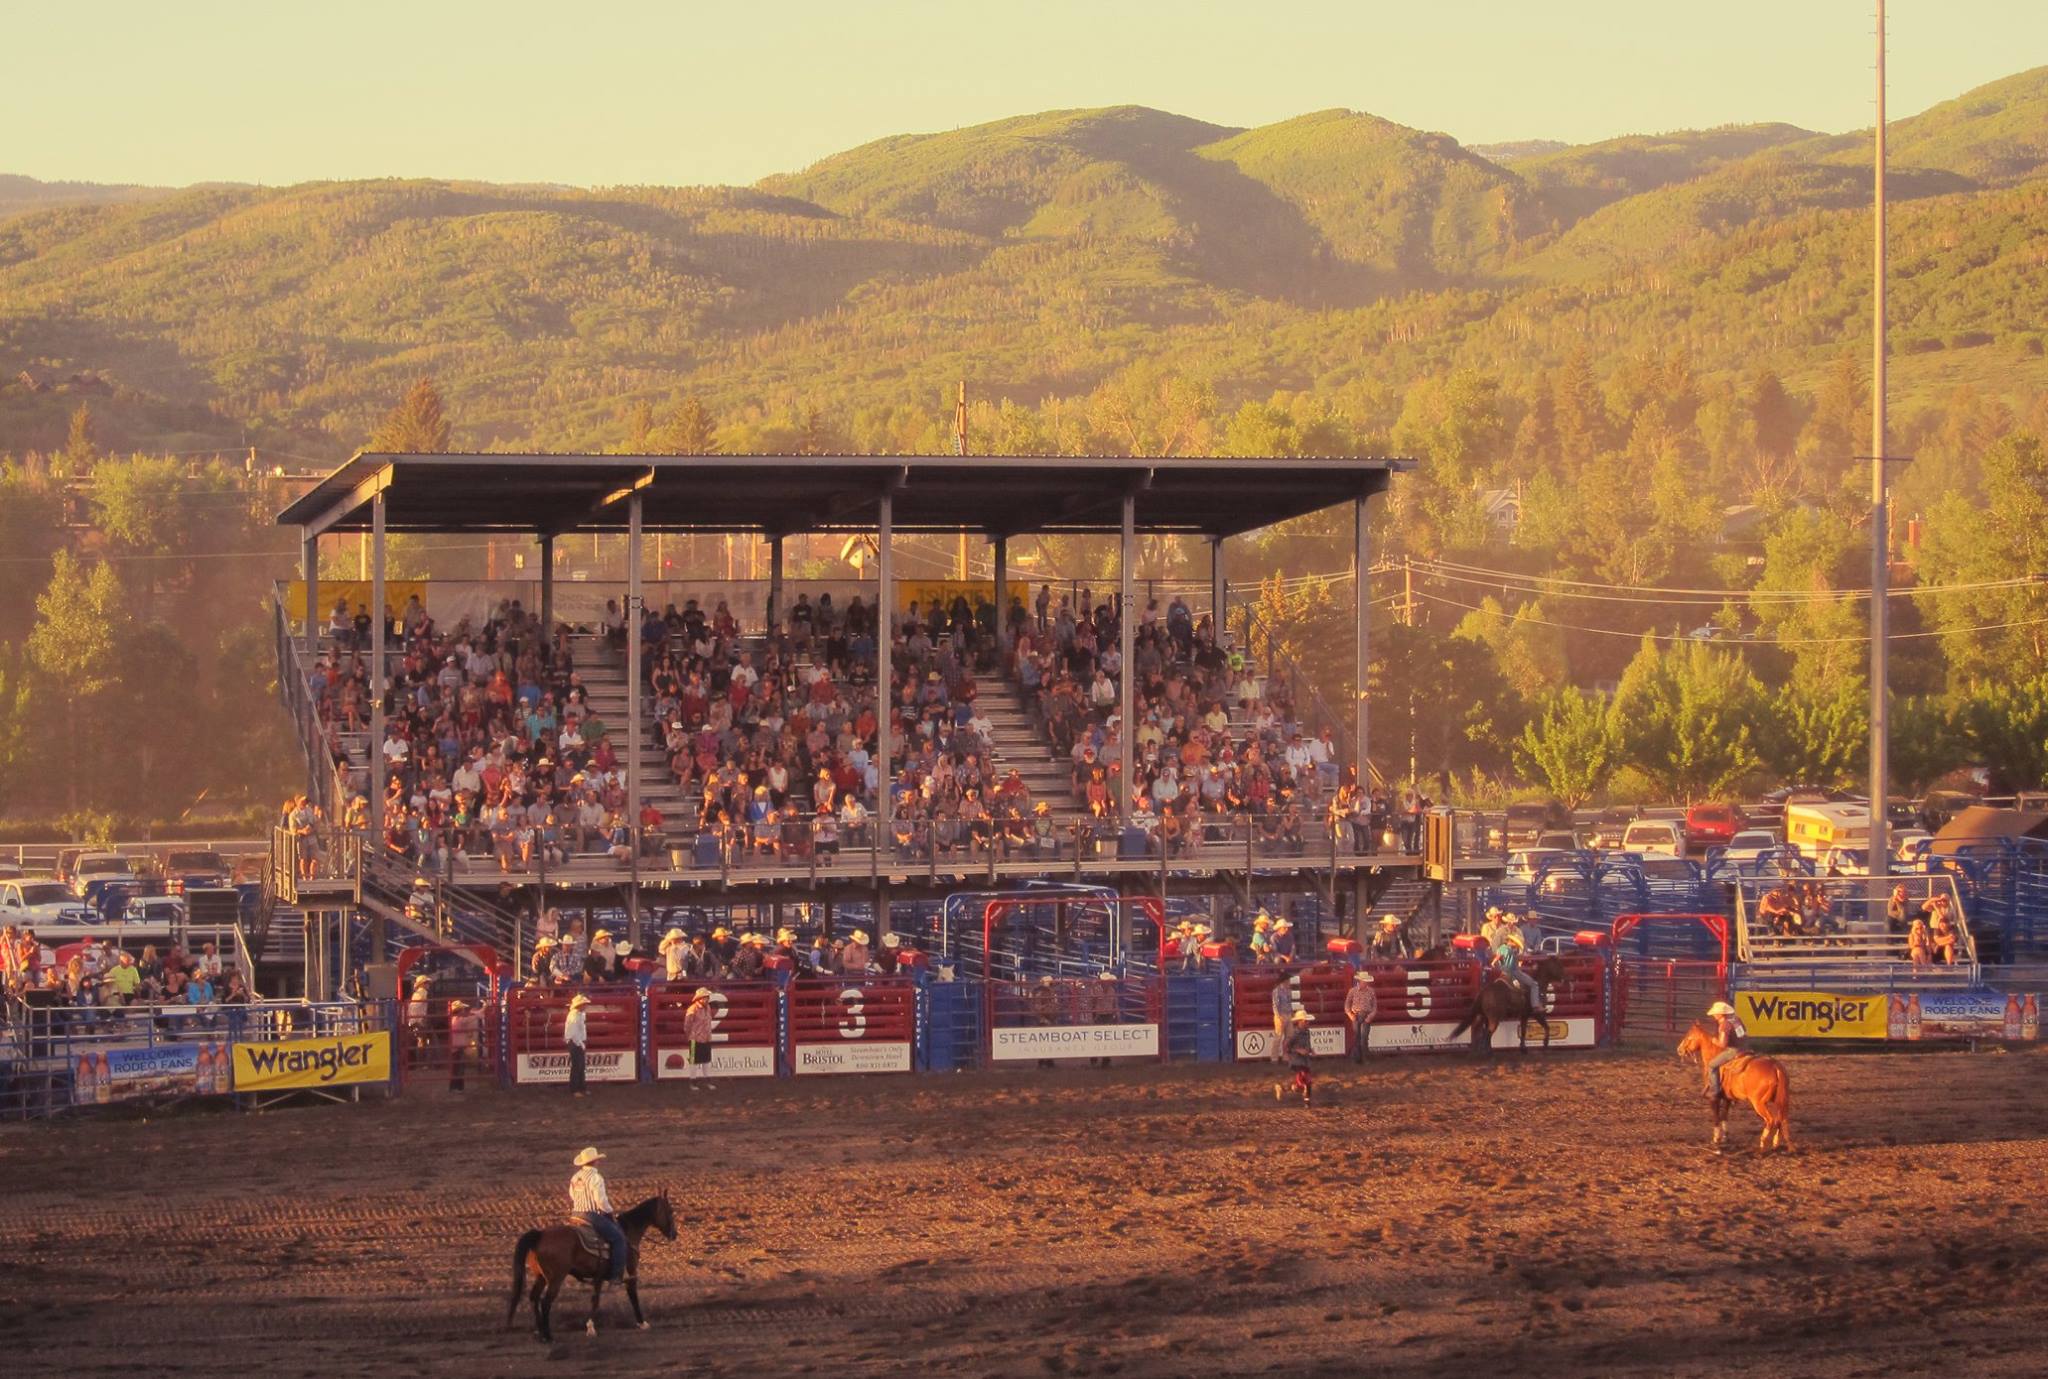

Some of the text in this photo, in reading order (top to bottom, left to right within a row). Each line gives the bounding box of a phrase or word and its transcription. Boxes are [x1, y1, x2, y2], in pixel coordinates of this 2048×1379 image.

[1406, 971, 1432, 1018] 5
[1933, 997, 1992, 1006] WELCOME
[709, 993, 729, 1042] 2
[839, 989, 866, 1038] 3
[1748, 996, 1869, 1033] Wrangler
[1925, 1006, 2001, 1015] RODEO FANS
[999, 1029, 1152, 1044] STEAMBOAT SELECT
[114, 1058, 193, 1073] RODEO FANS
[247, 1042, 373, 1081] Wrangler
[529, 1053, 624, 1069] STEABOAT
[803, 1053, 843, 1065] BRISTOL
